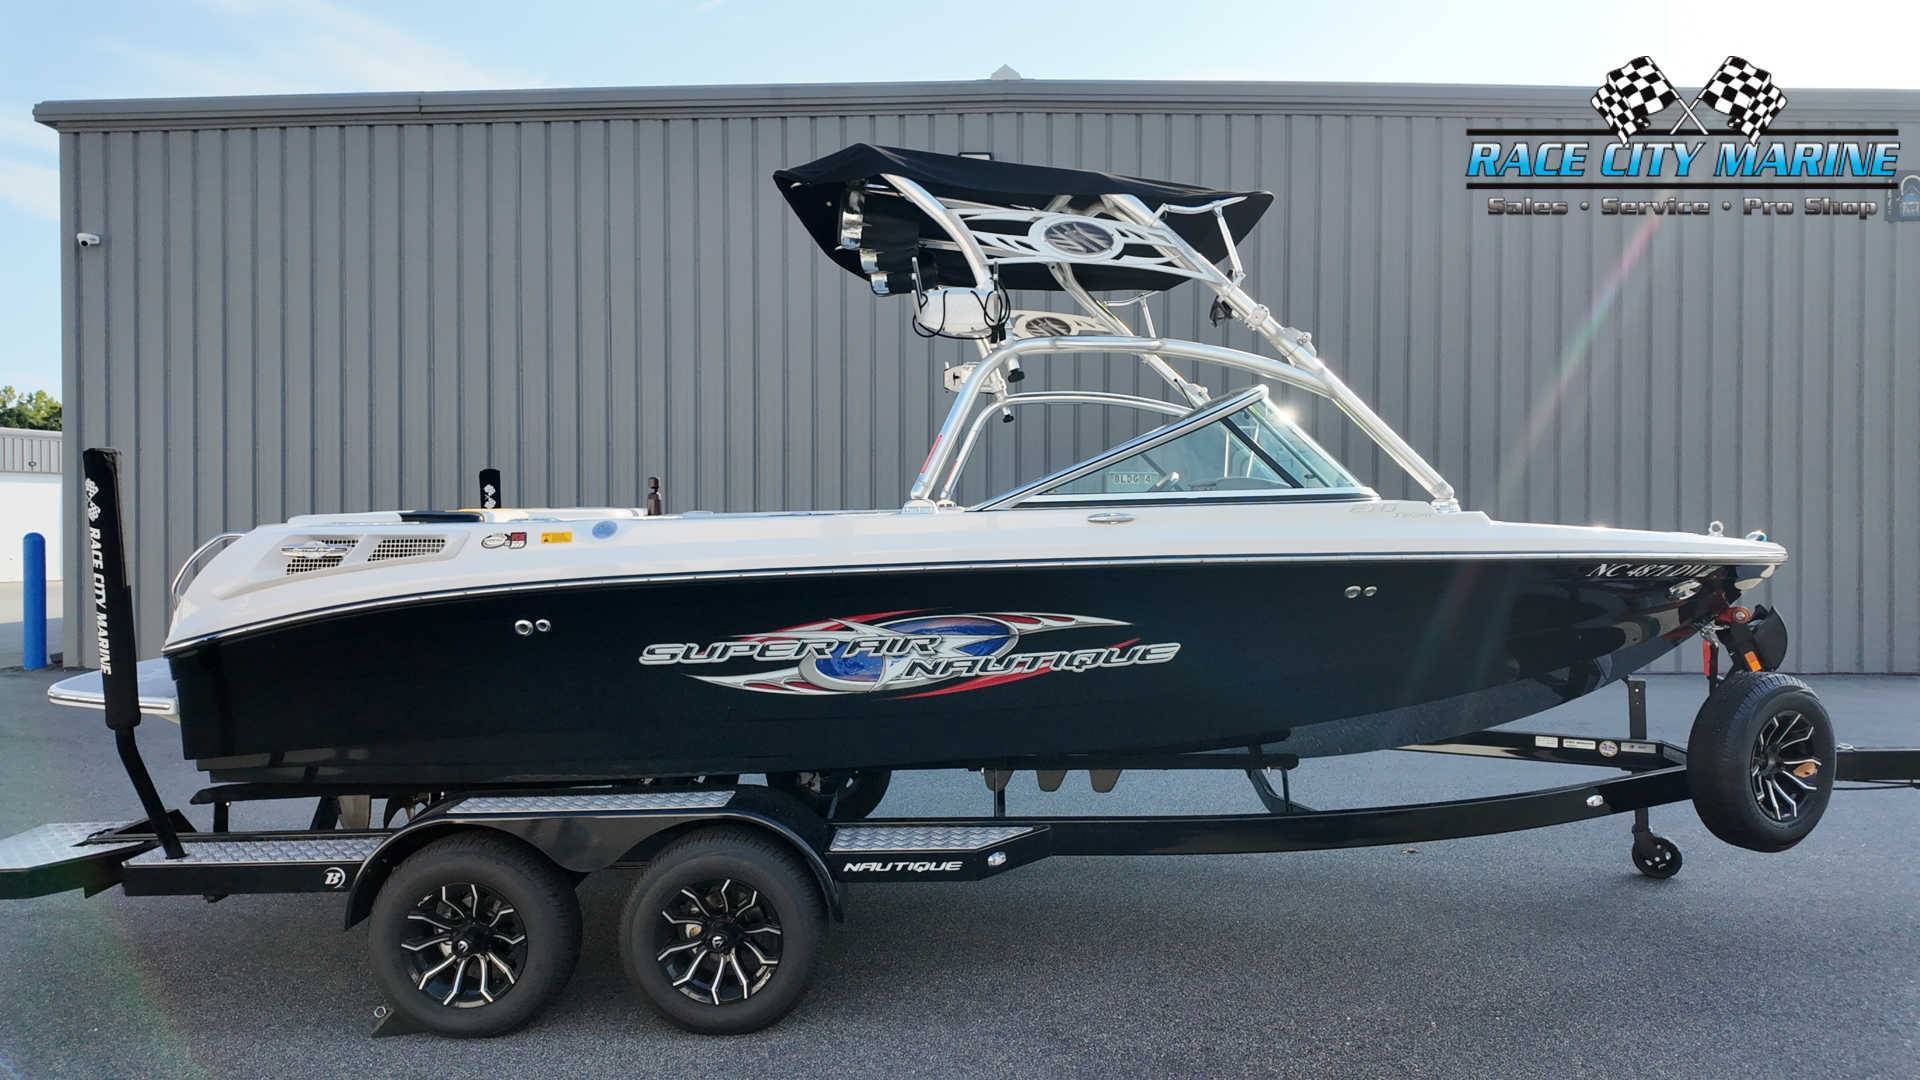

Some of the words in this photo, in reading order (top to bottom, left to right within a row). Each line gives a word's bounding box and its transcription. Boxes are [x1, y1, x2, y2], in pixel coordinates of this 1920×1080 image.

[89, 527, 102, 570] RACE
[94, 573, 106, 610] CITY
[97, 612, 112, 676] MARINE
[639, 638, 838, 665] SUPER
[841, 635, 943, 658] AIR
[901, 642, 1181, 679] NAUTIQUE
[843, 861, 963, 872] NAUTIQUE
